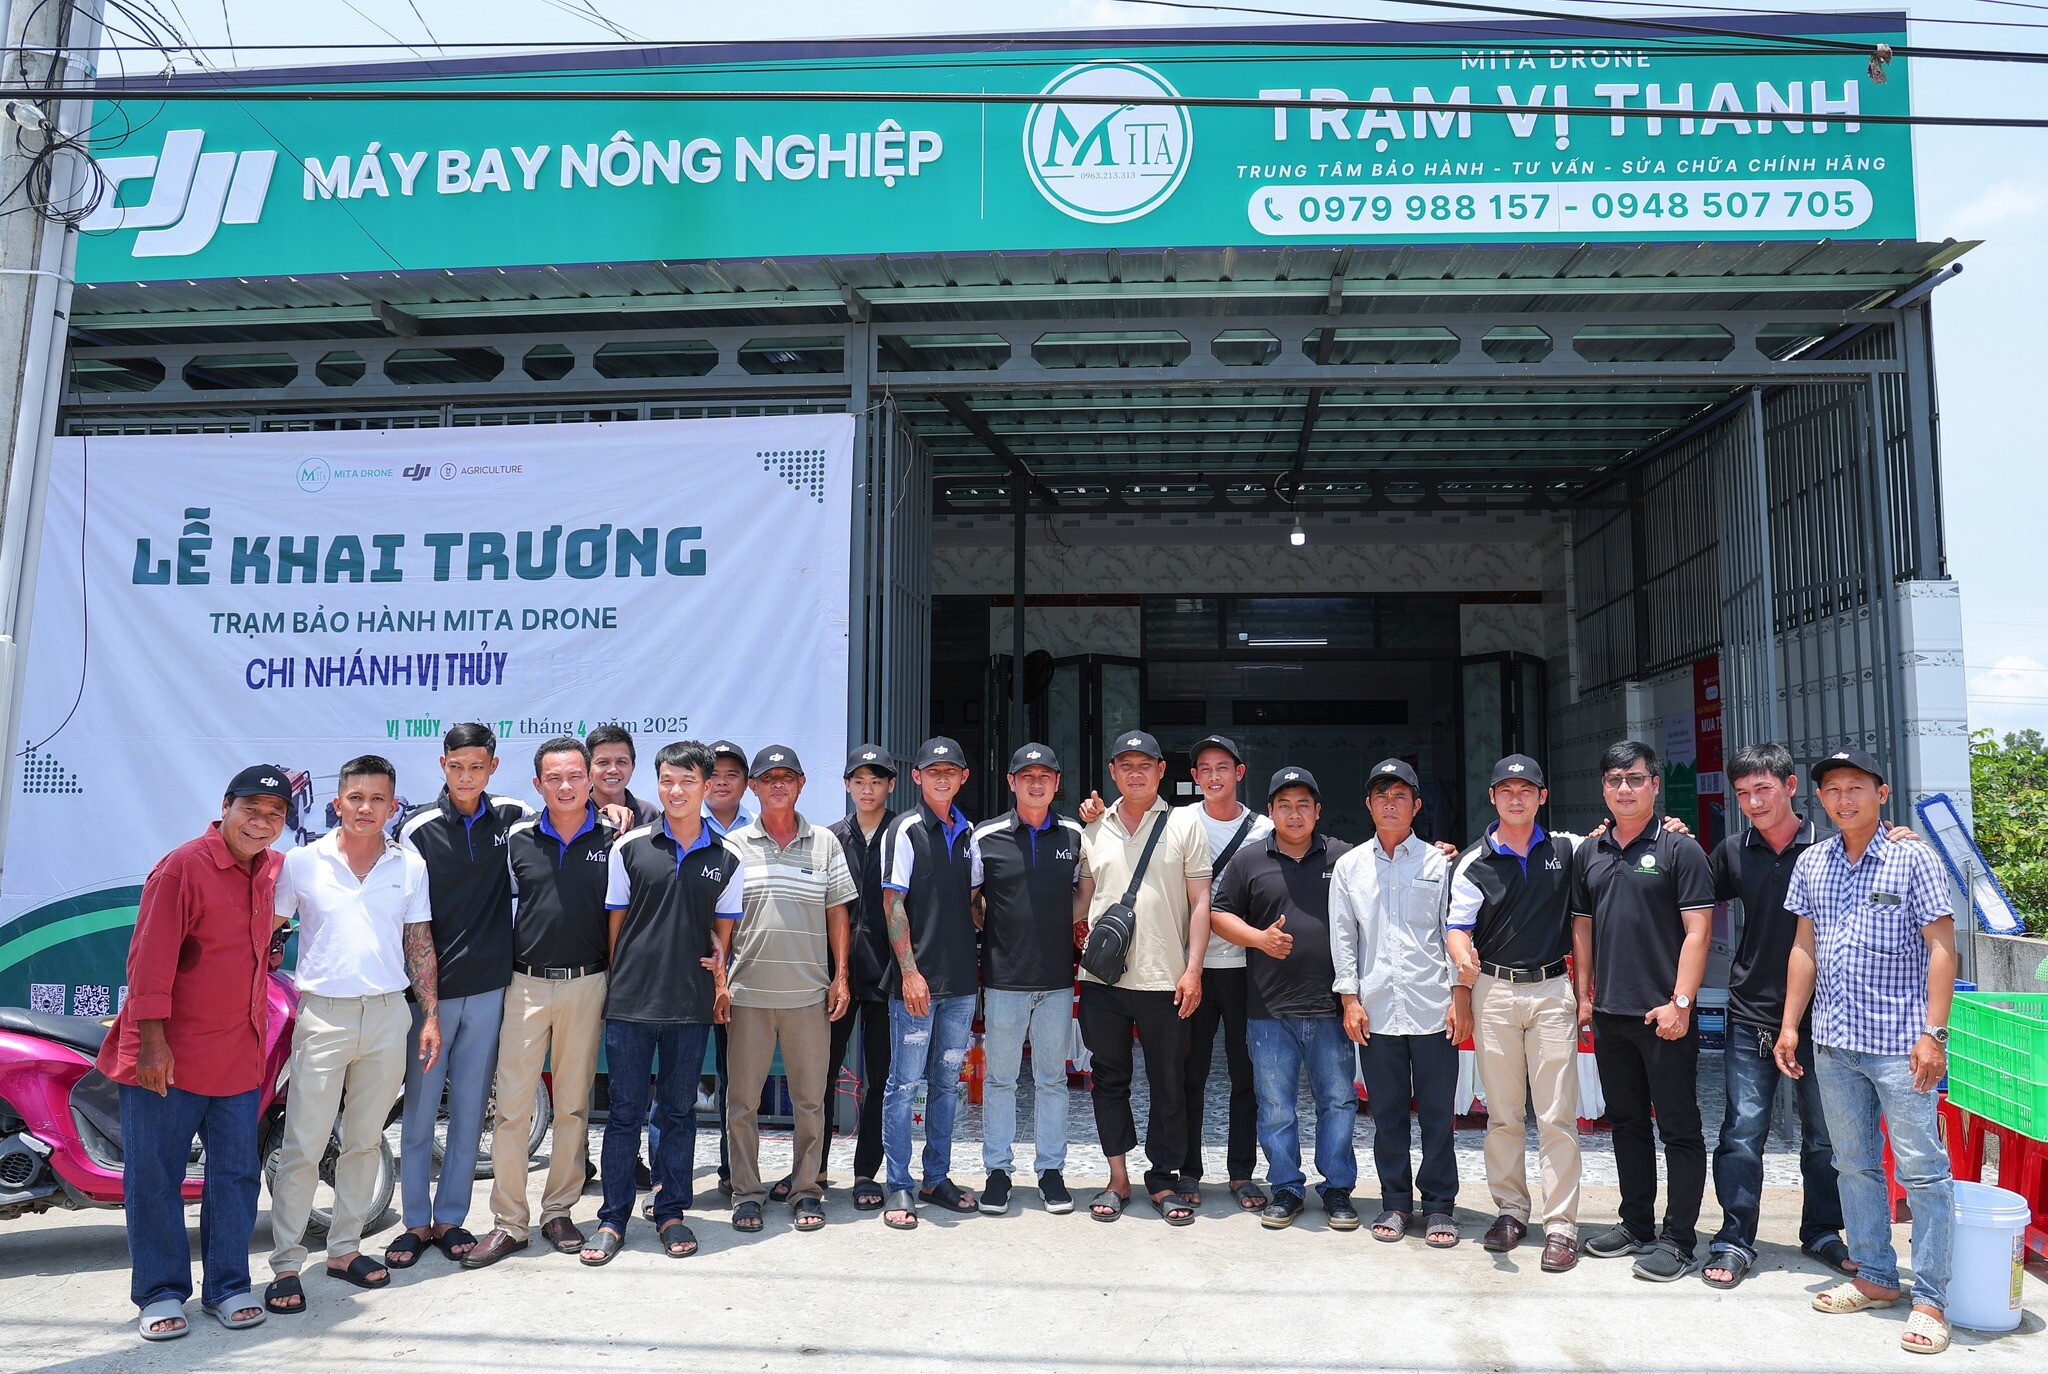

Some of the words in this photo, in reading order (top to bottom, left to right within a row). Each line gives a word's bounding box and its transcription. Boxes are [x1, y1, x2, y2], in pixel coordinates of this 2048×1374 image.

[1461, 50, 1536, 70] MITA
[1550, 49, 1650, 69] DRONE
[1259, 86, 1473, 154] TRẠM
[1497, 83, 1570, 151] VỊ
[1594, 78, 1862, 137] THANH
[303, 141, 429, 201] MÁY
[437, 145, 551, 195] BAY
[560, 129, 723, 189] NÔNG
[735, 118, 943, 188] NGHIỆP
[1236, 163, 1307, 179] TRUNG
[1317, 160, 1367, 178] TÂM
[1371, 157, 1415, 177] BẢO
[1424, 160, 1485, 177] HÀNH
[1512, 161, 1543, 175] TƯ
[1551, 156, 1595, 175] VẤN
[1621, 155, 1667, 175] SỬA
[1676, 156, 1739, 173] CHỮA
[1748, 154, 1818, 172] CHÍNH
[1825, 154, 1887, 172] HÃNG
[1080, 171, 1136, 180] 0963.213.313
[1298, 195, 1393, 223] 0979
[1405, 195, 1477, 222] 988
[1489, 194, 1551, 221] 157
[1591, 192, 1690, 220] 0948
[1702, 192, 1772, 219] 507
[1784, 190, 1855, 218] 705
[334, 471, 359, 479] MITA
[361, 468, 394, 478] DRONE
[460, 465, 523, 475] AGRICULTURE
[132, 506, 214, 586] LỄ
[229, 532, 407, 586] KHAI
[423, 523, 708, 583] TRƯƠNG
[209, 612, 285, 640] TRẠM
[291, 605, 350, 634] BẢO
[357, 605, 436, 633] HÀNH
[441, 608, 514, 632] MITA
[521, 606, 618, 631] DRONE
[245, 658, 296, 691] CHI
[303, 648, 415, 689] NHÁNH
[417, 653, 439, 692] VỊ
[446, 640, 508, 687] THỦY
[386, 719, 399, 740] VỊ
[498, 720, 514, 739] 17
[519, 717, 574, 738] tháng
[577, 720, 587, 738] 4
[643, 716, 689, 733] 2025
